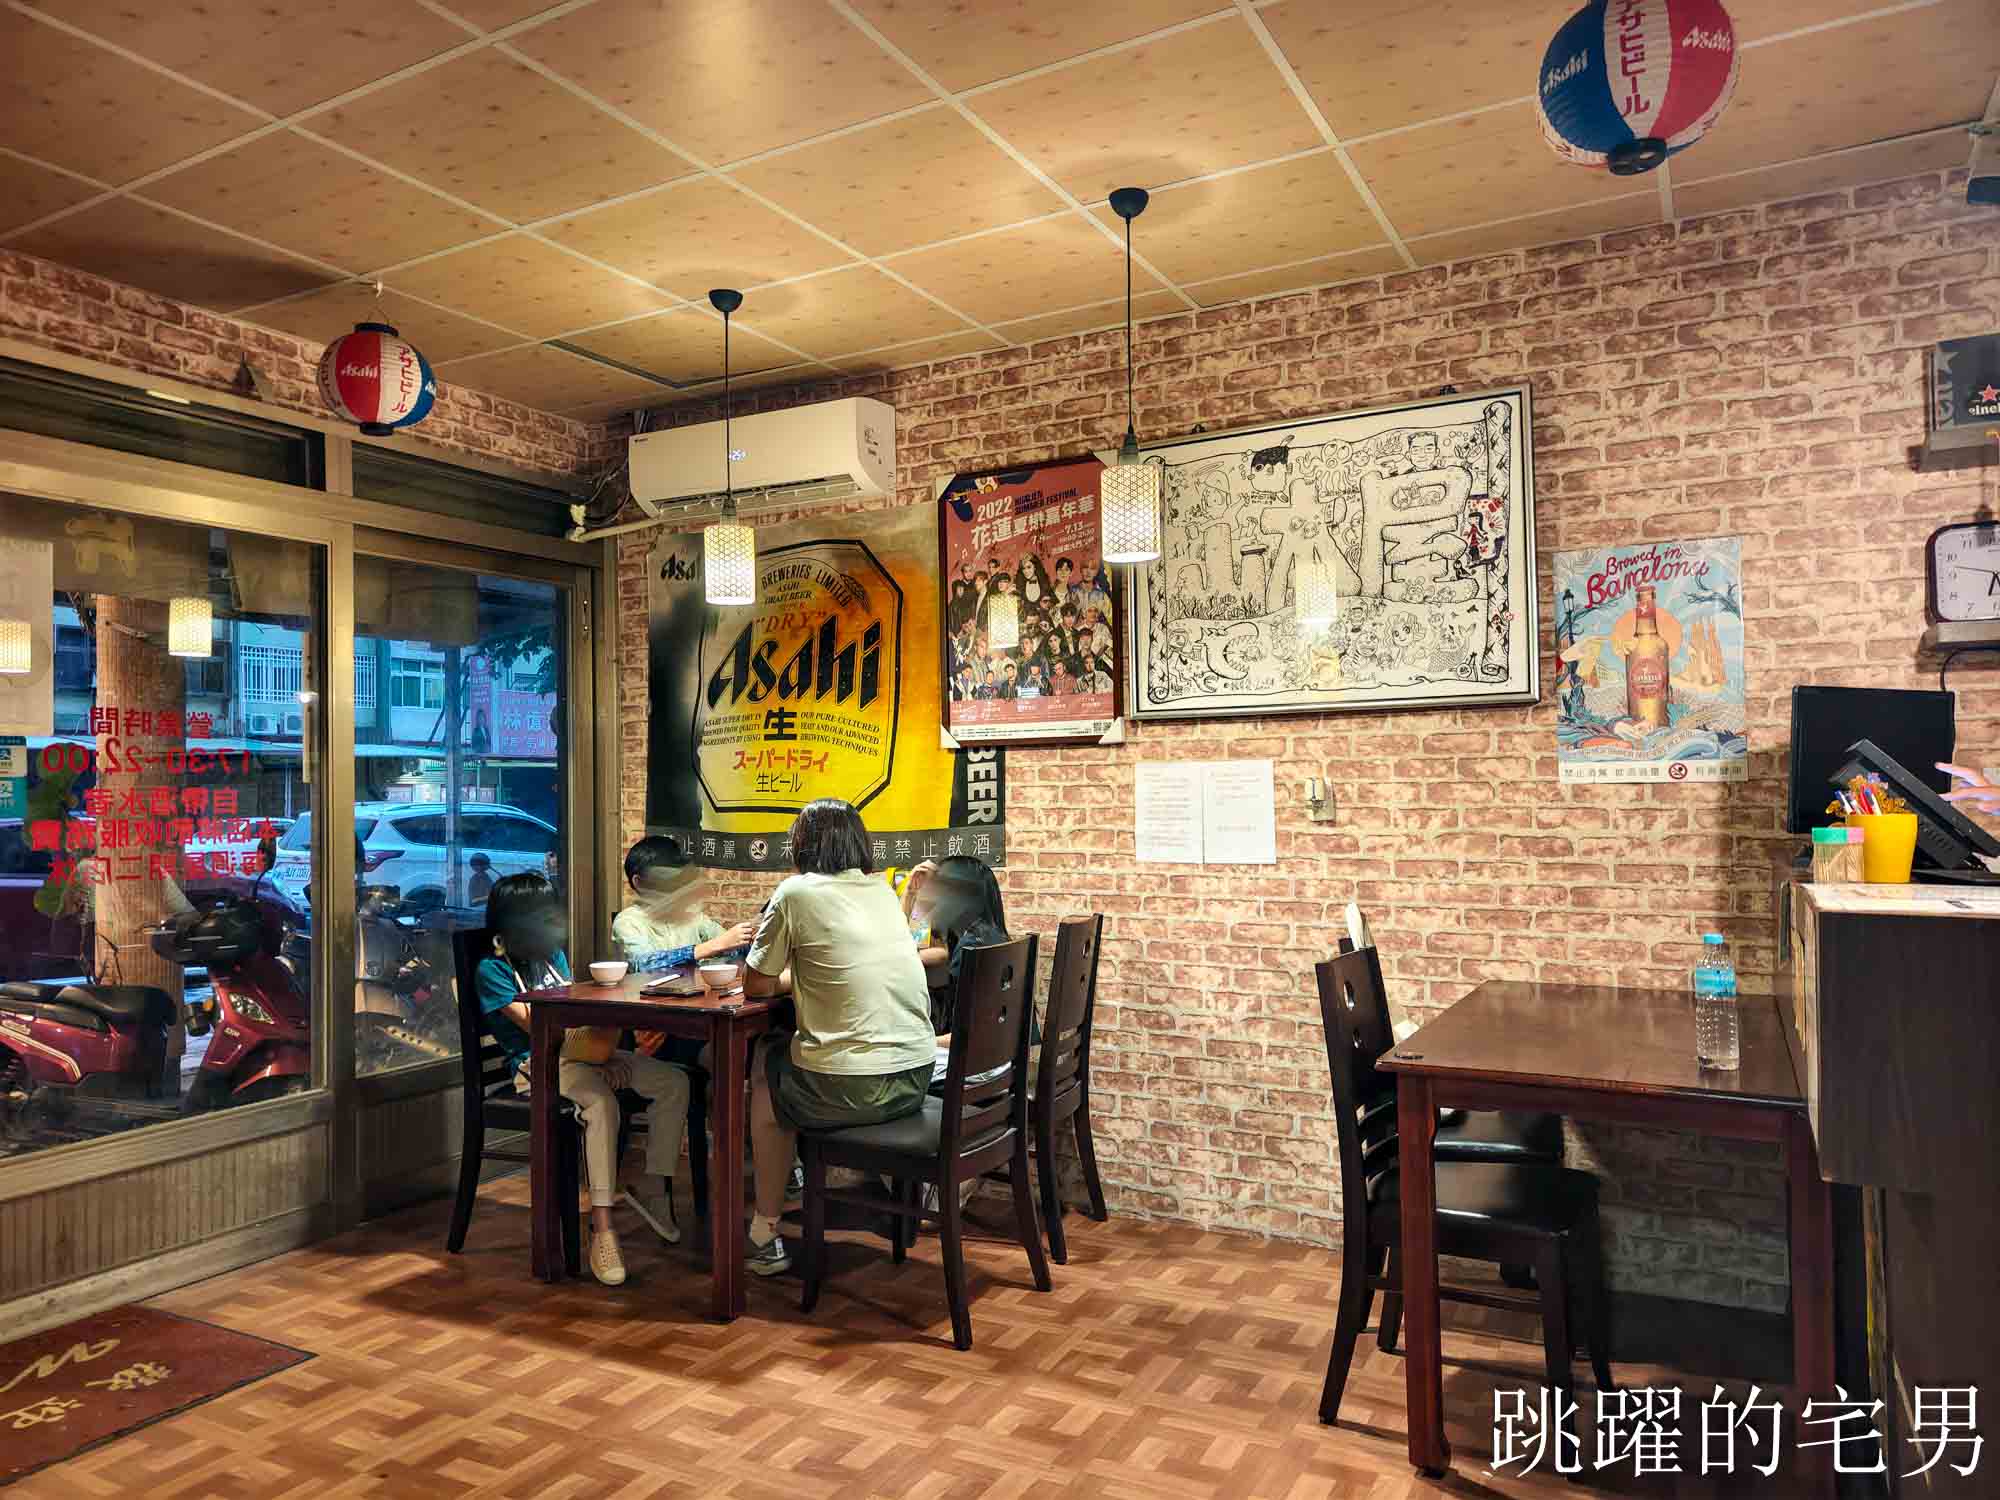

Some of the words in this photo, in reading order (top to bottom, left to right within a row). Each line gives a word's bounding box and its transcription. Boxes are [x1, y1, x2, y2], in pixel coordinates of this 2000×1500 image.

[1680, 26, 1731, 54] Asahi
[1543, 48, 1589, 95] Asahi
[340, 363, 378, 381] Asahi
[977, 496, 1013, 522] 2022
[1045, 487, 1079, 505] FESTIVAL
[660, 551, 704, 582] Asa
[1603, 545, 1658, 578] Brewed
[1663, 547, 1683, 561] in
[761, 564, 812, 591] BREWERIES
[815, 569, 850, 609] LIMITED
[1585, 556, 1711, 609] Barcelona
[707, 614, 882, 711] Asahi
[764, 707, 798, 741] 生
[815, 712, 836, 722] PURE
[837, 716, 880, 733] CULTURED
[816, 723, 829, 732] AND
[829, 725, 844, 735] OUR
[844, 729, 880, 745] ADVANCED
[733, 747, 830, 773] スーパードライ
[831, 737, 879, 757] TECHNIQUES
[755, 771, 802, 793] 生ビール
[966, 747, 998, 825] BEER
